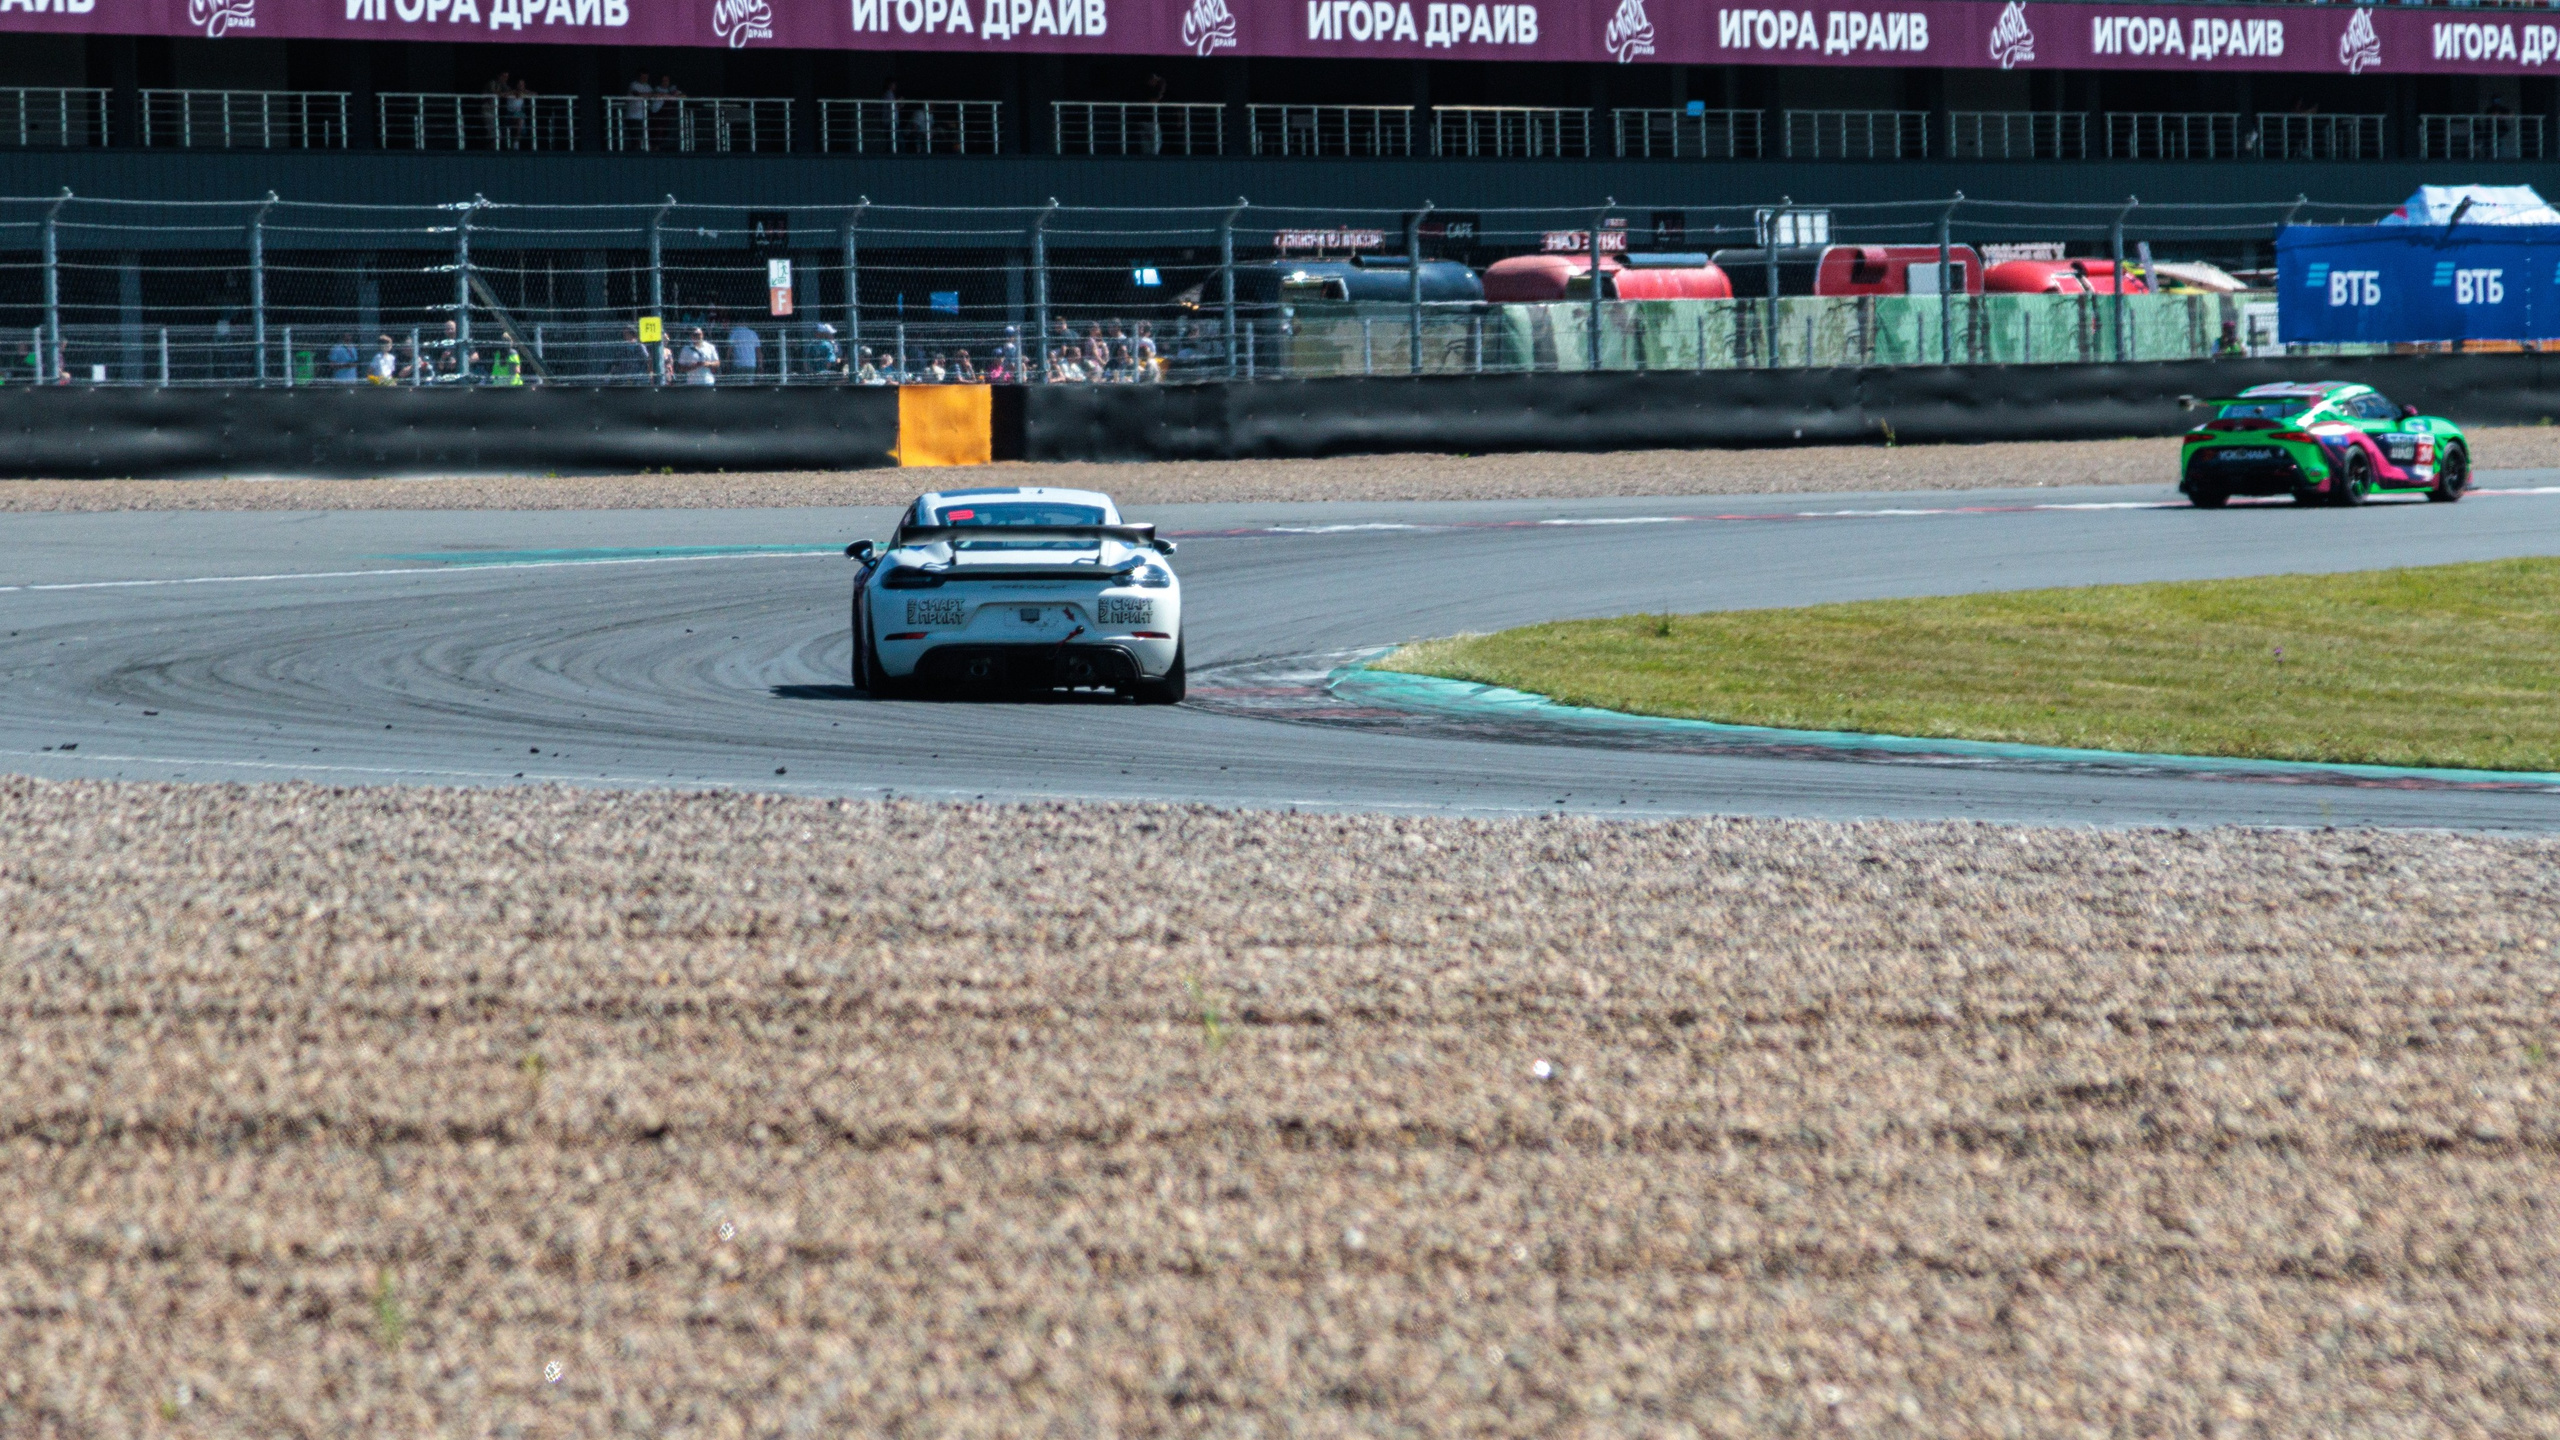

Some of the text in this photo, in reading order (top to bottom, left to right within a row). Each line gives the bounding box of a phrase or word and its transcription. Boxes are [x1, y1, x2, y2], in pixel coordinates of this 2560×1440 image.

[851, 0, 1107, 41] ИГОРА ДРАЙВ
[1308, 1, 1539, 48] ИГОРА ДРАЙВ
[1720, 9, 1929, 56] ИГОРА ДРАЙВ
[2094, 17, 2284, 60] ИГОРА ДРАЙВ
[2433, 23, 2560, 66] ИГОРА ДР
[777, 291, 787, 312] F
[2329, 270, 2382, 306] ВТБ
[2455, 268, 2505, 305] ВТБ
[919, 598, 965, 611] СМАРТ
[919, 611, 965, 625] ПРИНТ
[1111, 598, 1154, 611] СМАРТ
[1111, 611, 1154, 624] ПРИНТ
